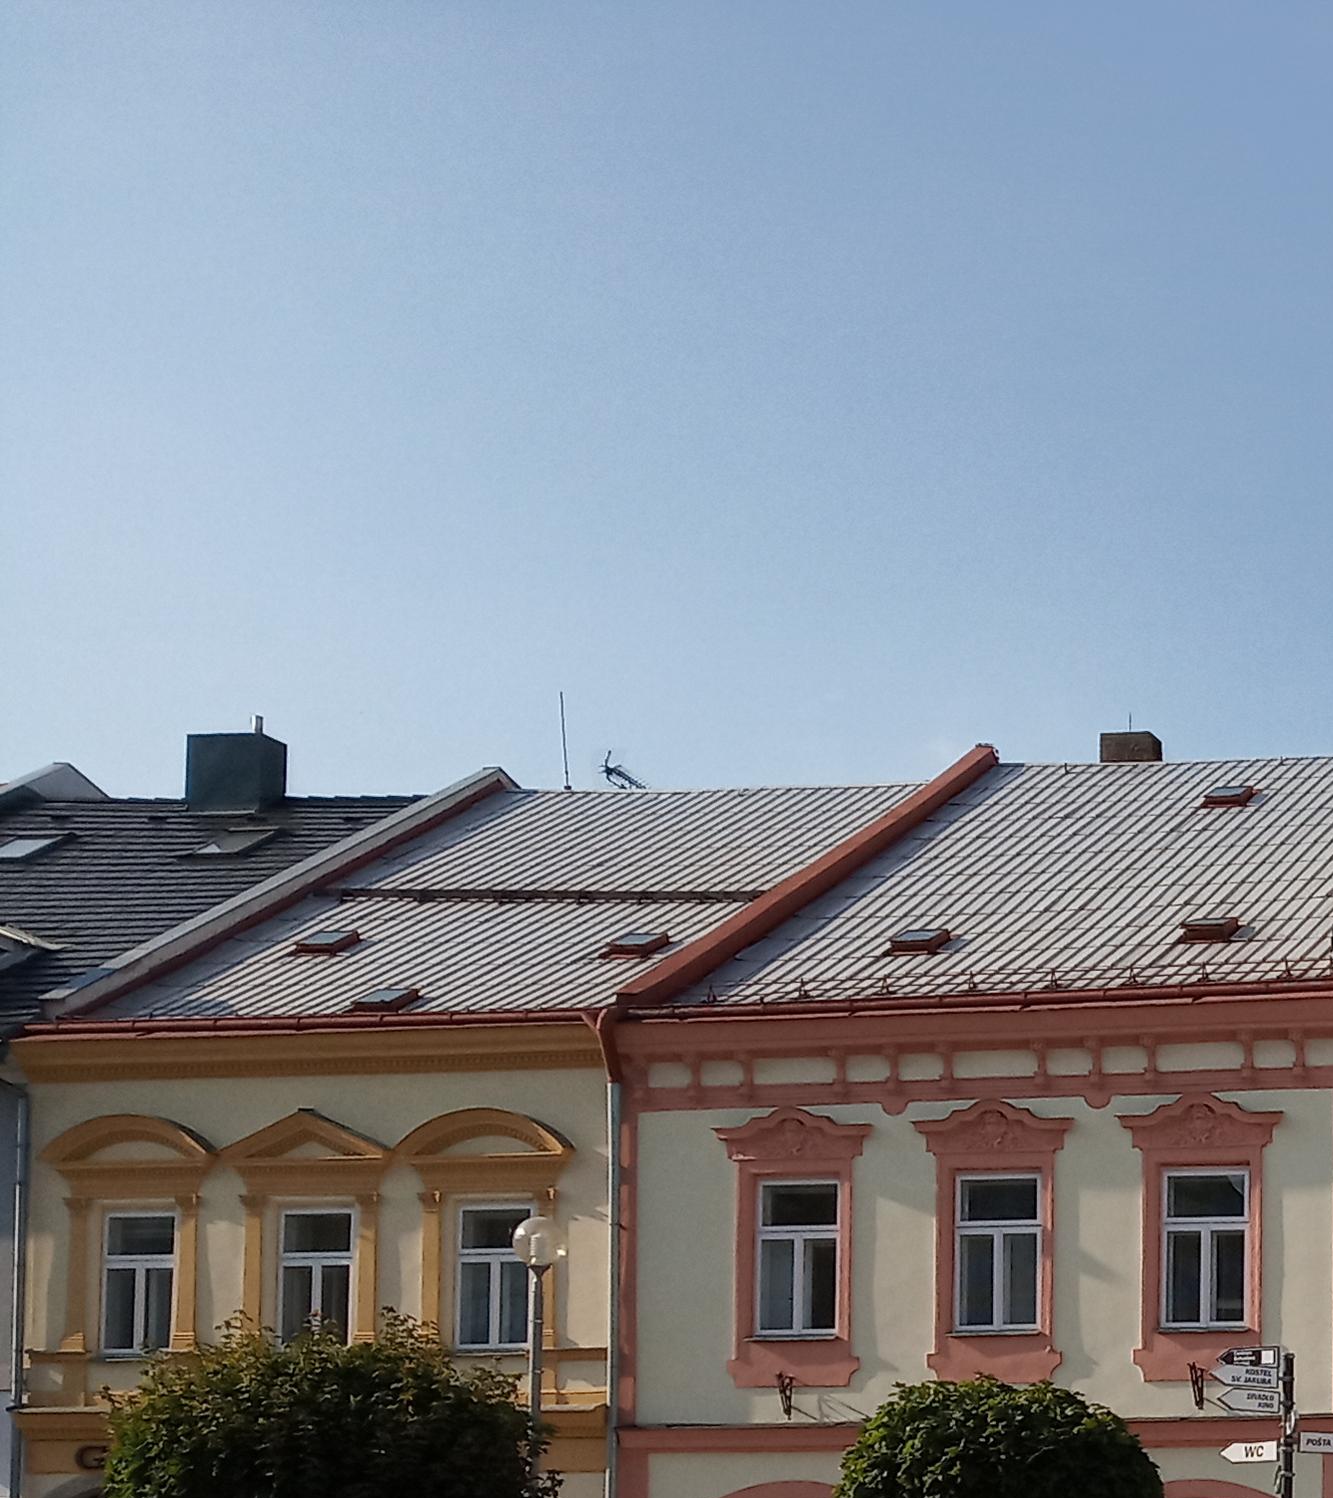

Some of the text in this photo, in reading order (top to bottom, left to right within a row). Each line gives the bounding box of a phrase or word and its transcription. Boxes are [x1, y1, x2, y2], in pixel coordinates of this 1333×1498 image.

[1245, 1369, 1272, 1377] KOSTEL
[1305, 1436, 1332, 1447] POŠTA
[1244, 1445, 1265, 1458] WC
